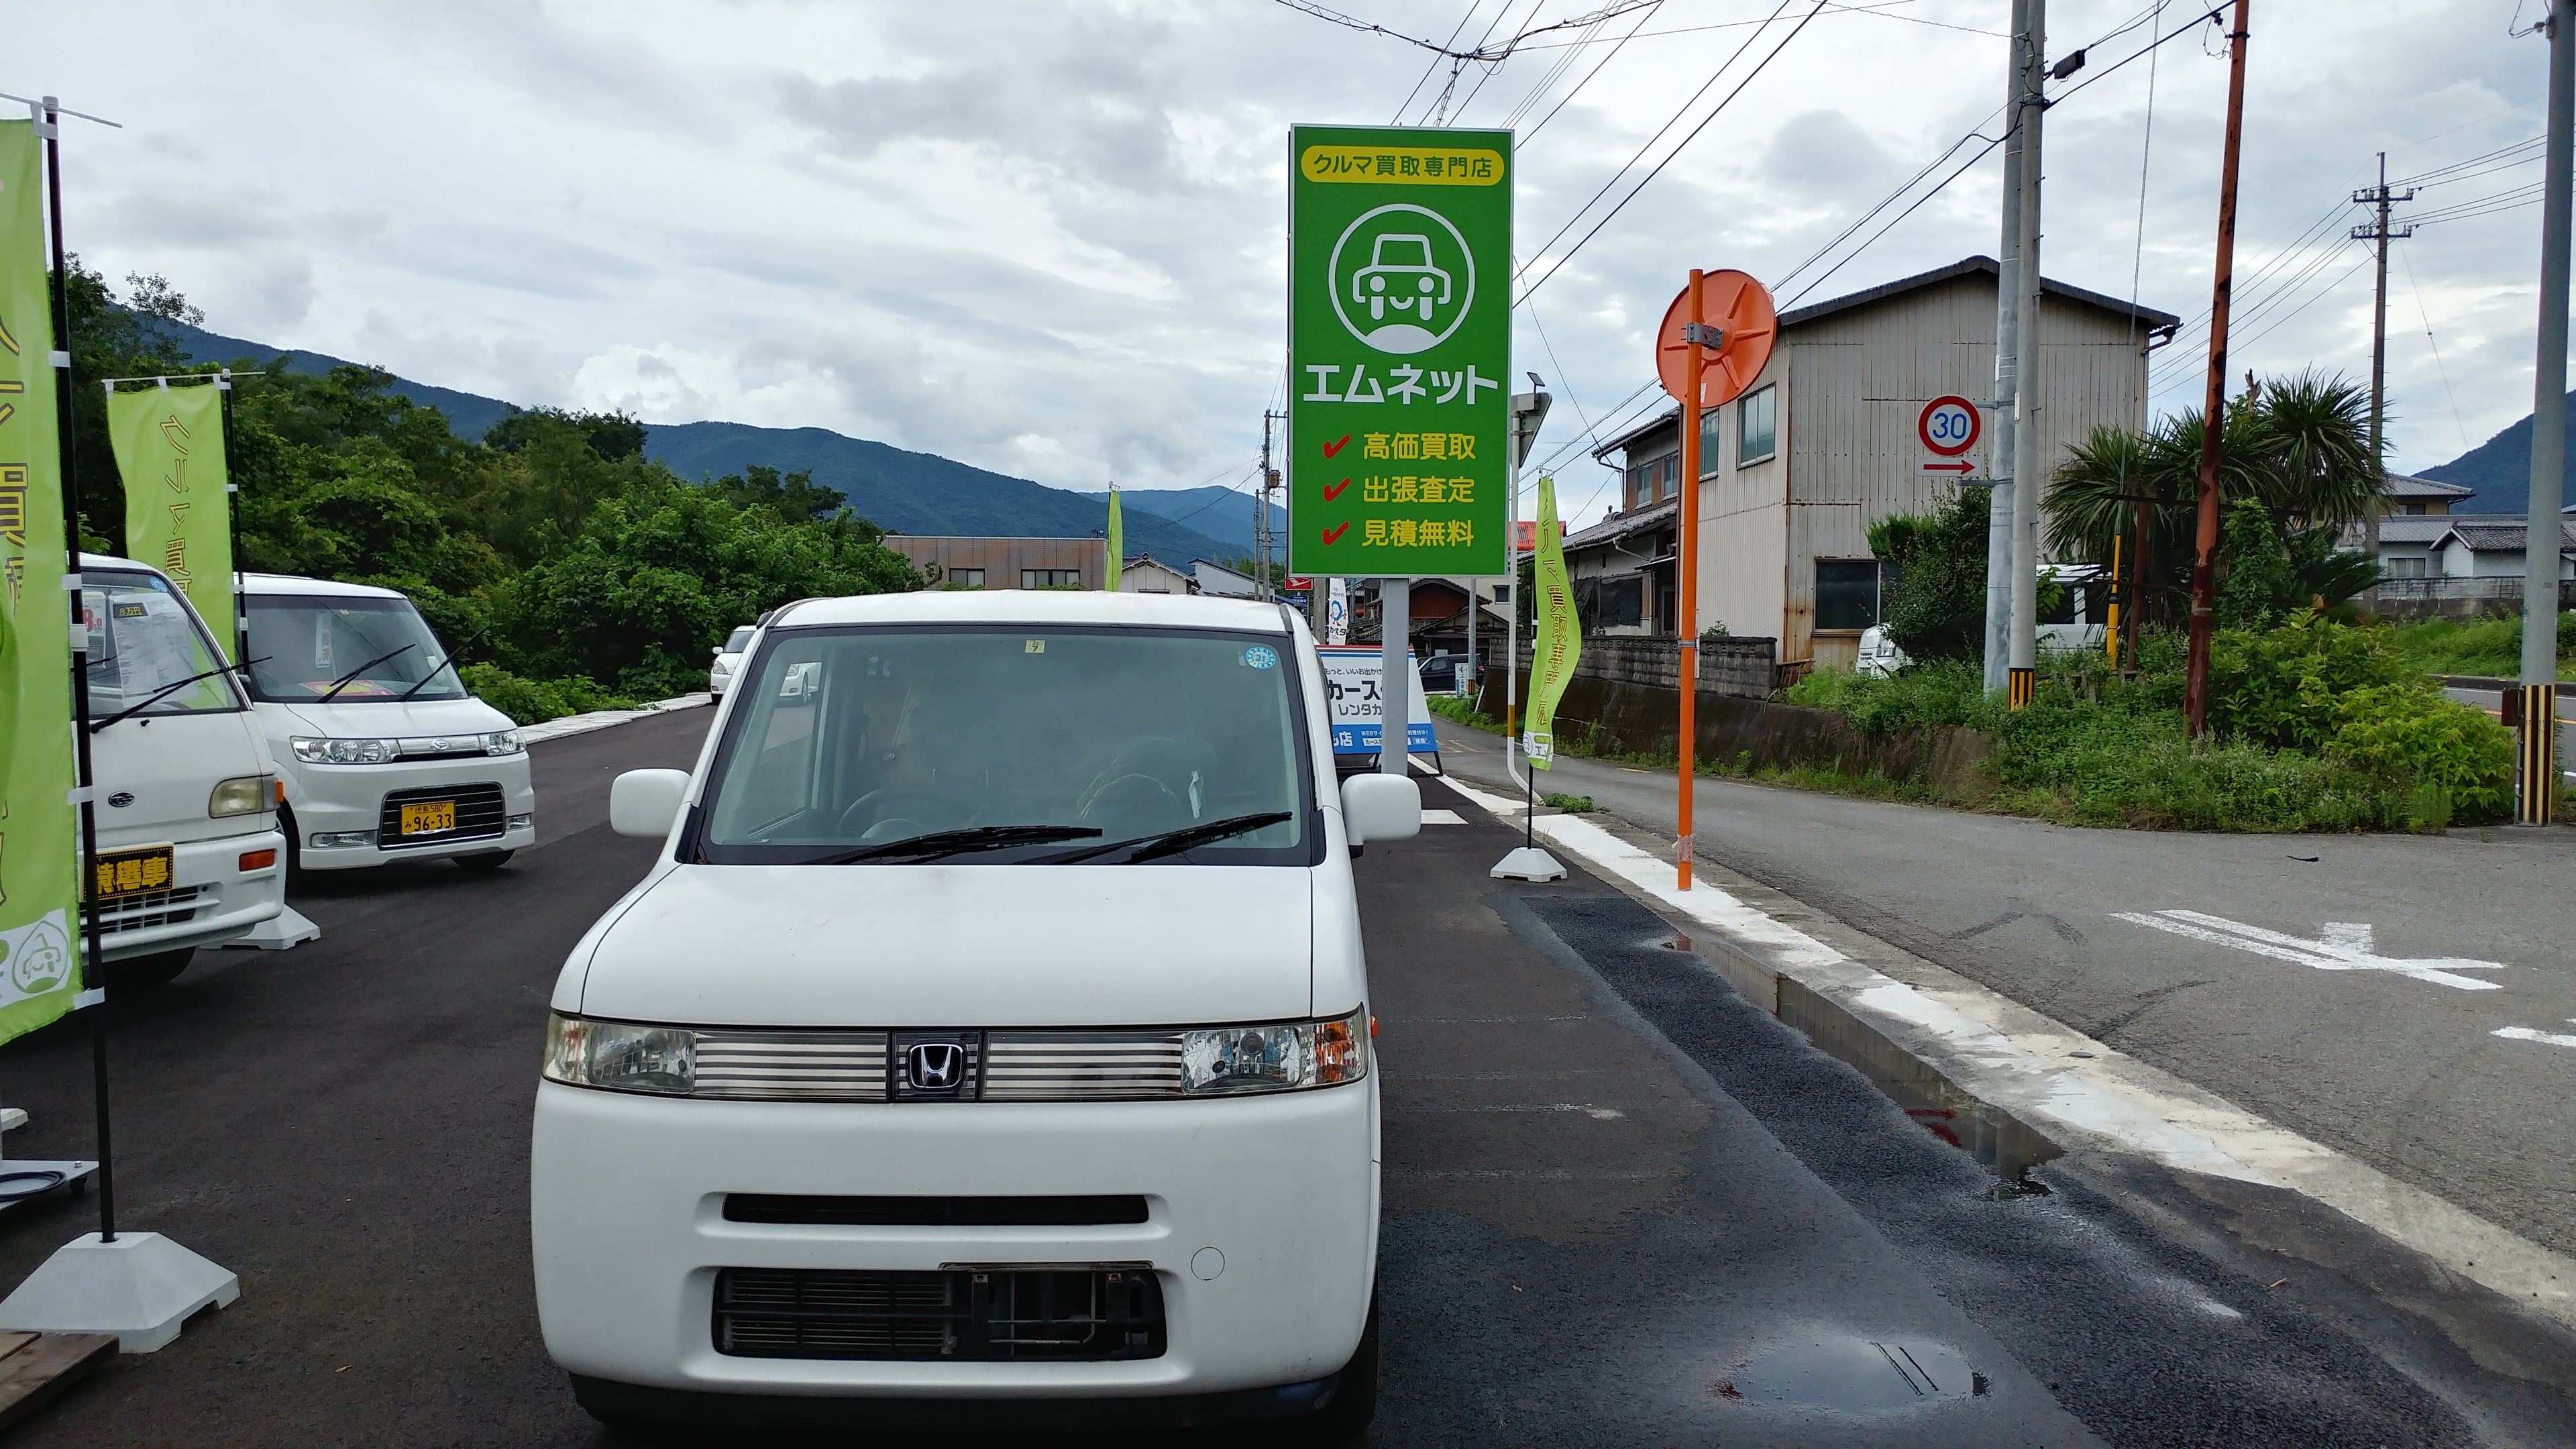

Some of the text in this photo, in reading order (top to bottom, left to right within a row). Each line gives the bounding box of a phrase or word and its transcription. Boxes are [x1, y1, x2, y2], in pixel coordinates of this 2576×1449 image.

[1313, 153, 1493, 179] クルマ買取専門店
[1303, 364, 1499, 406] エムネット
[1932, 413, 1968, 439] 30
[1362, 431, 1477, 462] 高価買取
[1362, 475, 1476, 504] 出張査定
[1360, 518, 1475, 549] 見積無料
[119, 606, 143, 616] 8万円
[1256, 654, 1266, 662] 31
[1327, 680, 1382, 701] カース
[430, 804, 443, 813] 580
[413, 813, 451, 832] 96-33
[97, 856, 169, 895] 特選車
